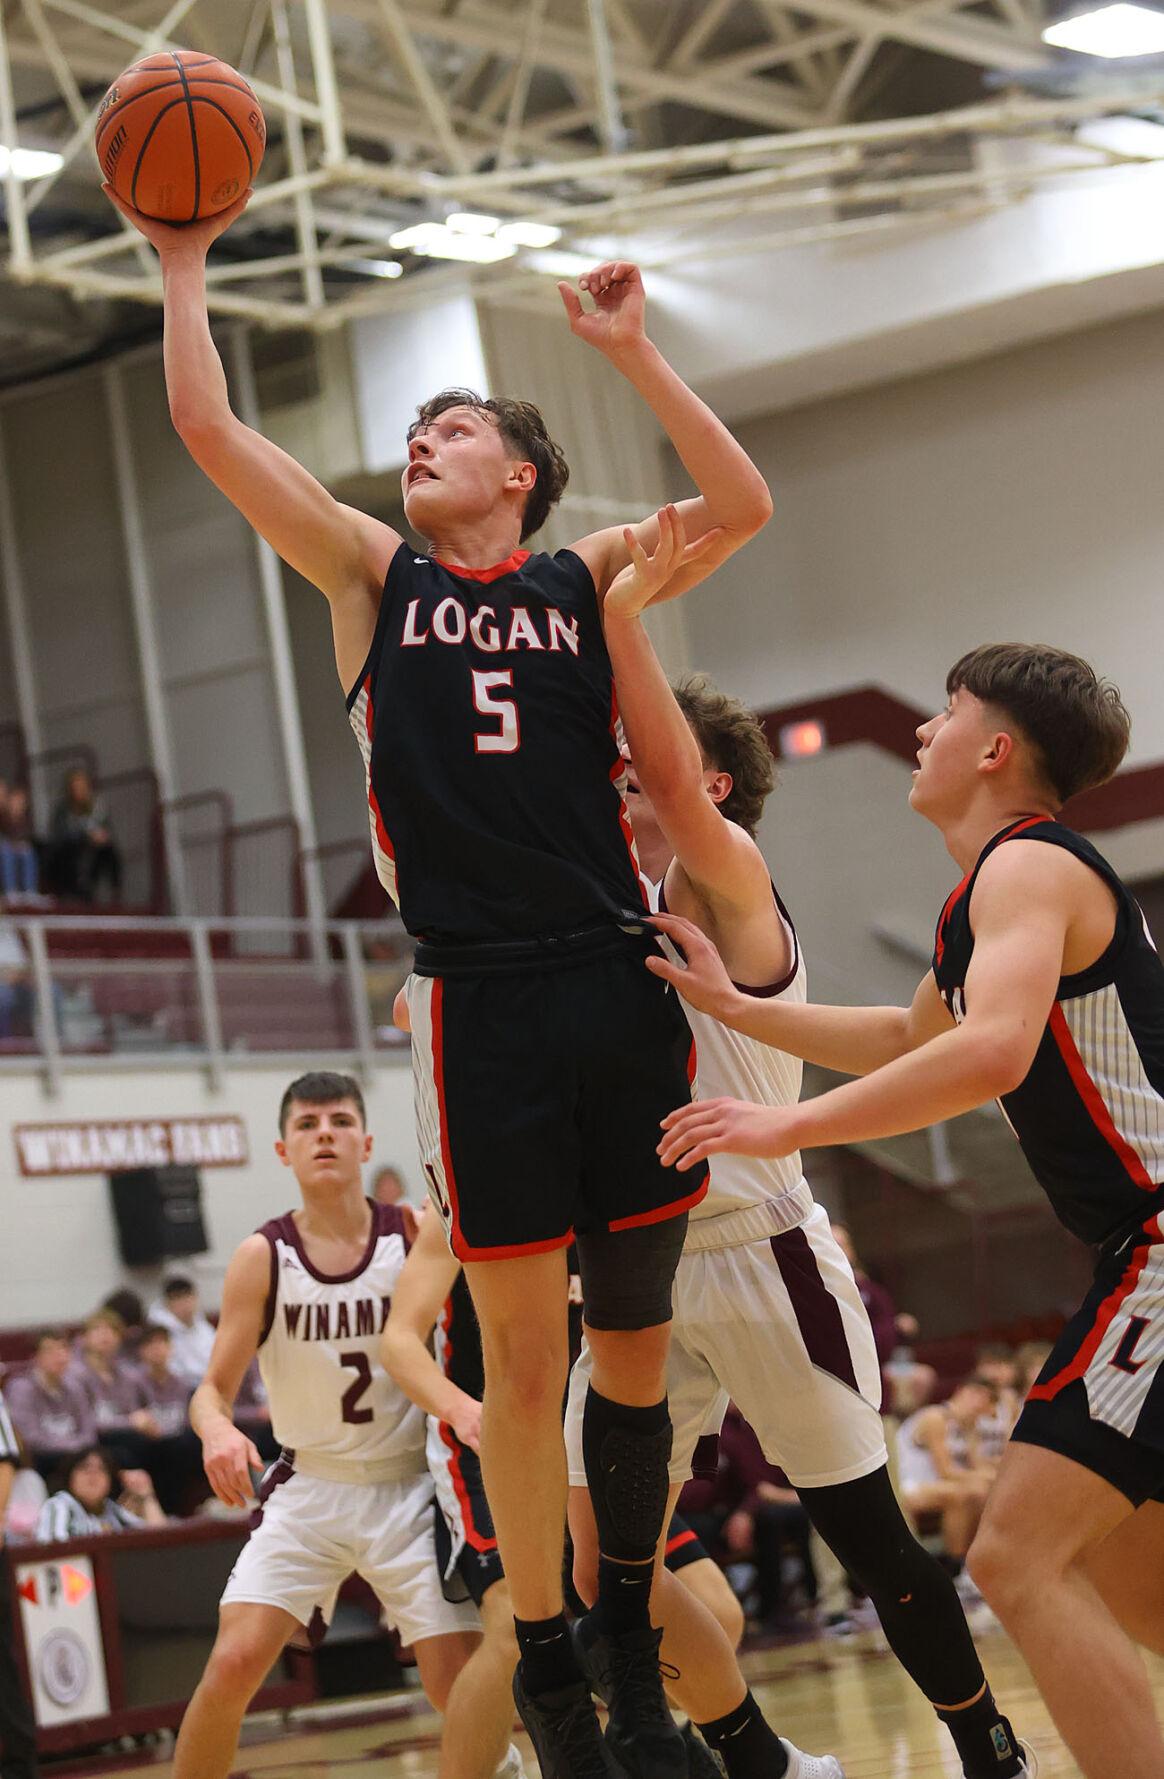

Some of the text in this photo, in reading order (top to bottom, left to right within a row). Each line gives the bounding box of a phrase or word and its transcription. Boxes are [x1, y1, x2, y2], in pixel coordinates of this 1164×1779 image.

[400, 597, 579, 656] LOGAN
[471, 666, 521, 754] 5
[1108, 1314, 1152, 1375] L
[340, 1352, 374, 1424] 2
